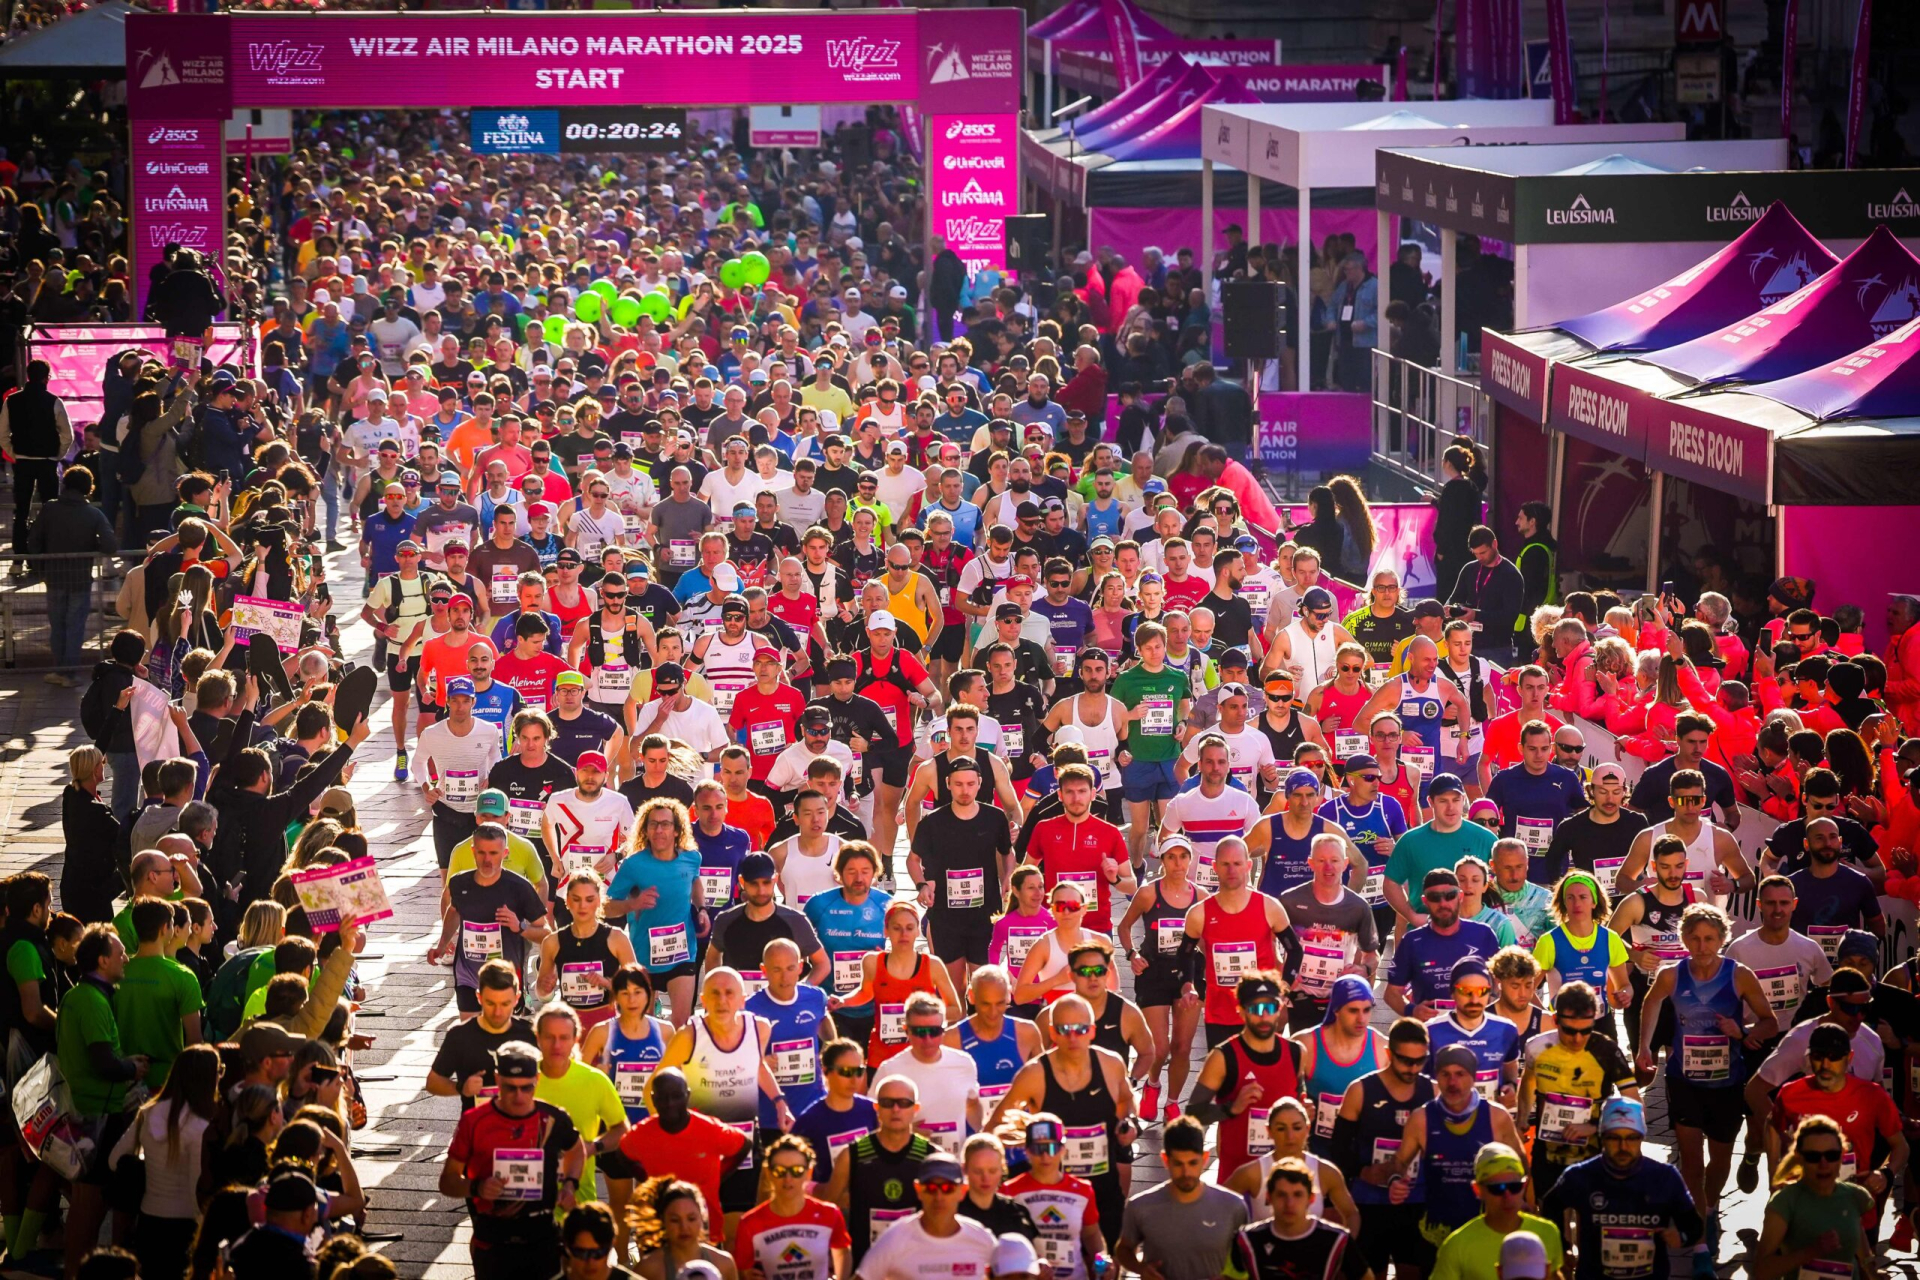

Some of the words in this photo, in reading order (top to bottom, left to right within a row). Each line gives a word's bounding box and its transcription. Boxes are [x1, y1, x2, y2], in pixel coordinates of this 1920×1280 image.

[349, 37, 418, 56] WIZZ
[426, 37, 470, 56] AIR
[477, 37, 579, 56] MILANO
[586, 35, 734, 55] MARATHON
[740, 34, 803, 54] 2025
[972, 54, 995, 62] WIZZ
[996, 54, 1012, 62] AIR
[971, 62, 1012, 70] MILANO
[182, 69, 224, 77] MILANO
[535, 67, 624, 89] START
[843, 73, 901, 81] wizzair.com
[267, 76, 325, 84] wizzair.com
[565, 122, 682, 140] 00:20:24
[483, 131, 545, 145] FESTINA
[160, 162, 209, 174] UniCredit
[957, 156, 1005, 169] UniCredit
[942, 189, 1005, 207] LEVISSIMA
[145, 197, 208, 212] LEVISSIMA
[1546, 207, 1615, 225] LEVISSIMA
[1706, 205, 1772, 222] LEVISSIM
[1491, 348, 1511, 386] PRESS
[1511, 360, 1531, 400] ROOM
[1567, 384, 1597, 426] PRESS
[1599, 396, 1629, 437] ROOM
[1275, 421, 1298, 433] AIR
[1669, 420, 1705, 465] PRESS
[1707, 430, 1744, 477] ROOM
[508, 676, 546, 688] Aleimar
[824, 928, 852, 937] Atletica
[714, 1068, 737, 1077] TEAM
[718, 1089, 736, 1098] ASD
[1592, 1213, 1661, 1225] FEDERICO
